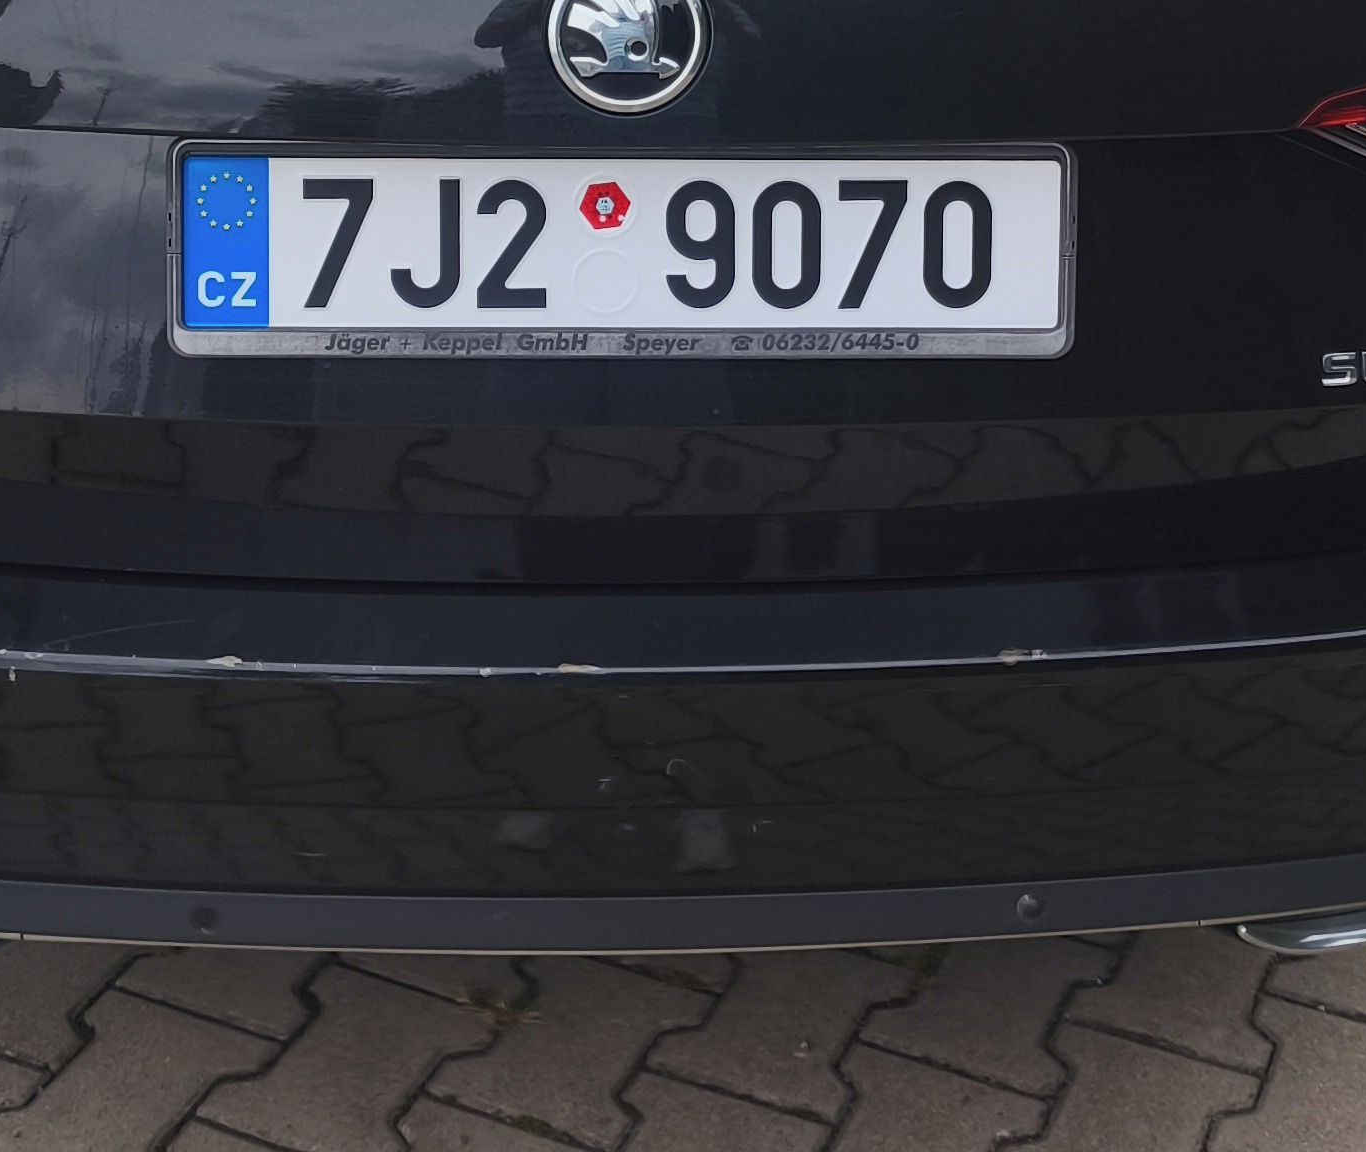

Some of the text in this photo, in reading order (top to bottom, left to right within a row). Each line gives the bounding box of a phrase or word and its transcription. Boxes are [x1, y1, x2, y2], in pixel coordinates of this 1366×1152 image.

[302, 178, 993, 309] 7J2 9070
[197, 270, 257, 308] CZ
[325, 332, 921, 355] Jäger + Keppel GmbH Speyer 06232/6445-0
